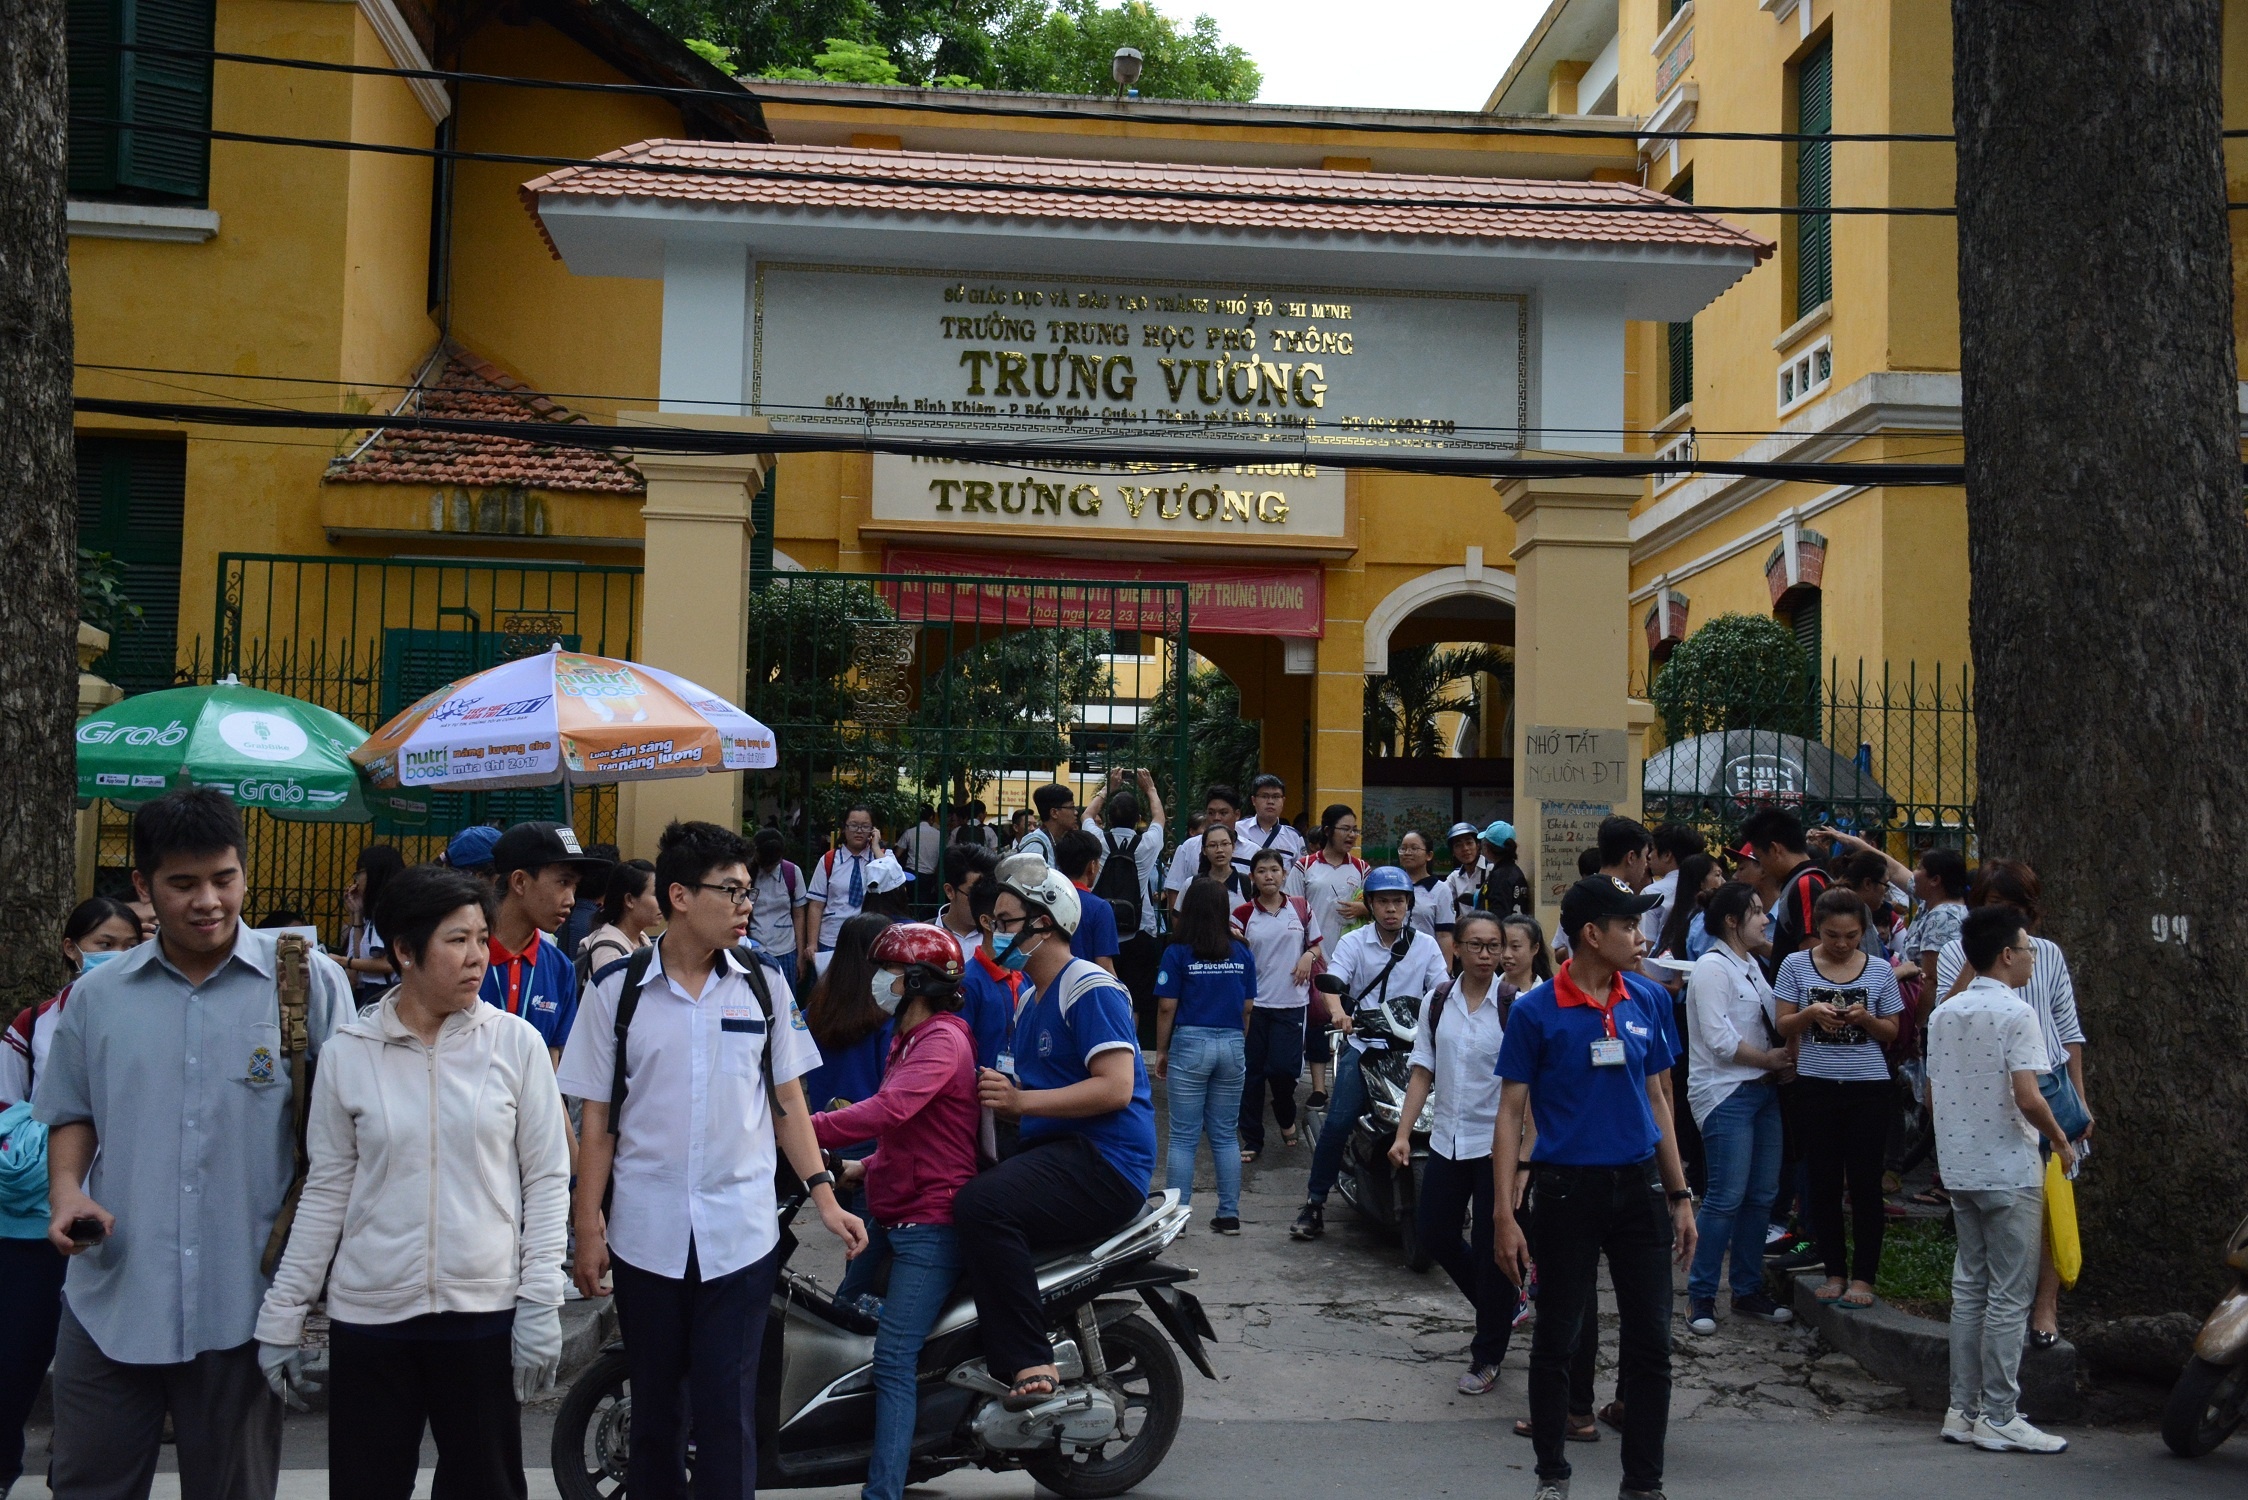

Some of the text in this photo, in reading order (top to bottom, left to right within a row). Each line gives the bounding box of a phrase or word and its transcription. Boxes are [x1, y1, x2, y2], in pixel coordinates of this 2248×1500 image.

[968, 285, 1007, 305] GIÁO
[1012, 286, 1044, 311] DỤC
[1050, 287, 1070, 309] VÀ
[1117, 295, 1148, 315] TẠO
[1311, 303, 1352, 320] MINH
[940, 310, 1354, 355] TRƯỜNG TRUNG HỌC PHỔ THÔNG
[959, 345, 1328, 408] TRƯNG VƯƠNG
[951, 400, 997, 416] Khiêm
[928, 476, 1290, 524] TRƯNG VƯƠNG
[1187, 582, 1212, 607] HPT
[1214, 580, 1258, 608] TRƯNG
[1261, 580, 1304, 610] VƯƠNG
[76, 720, 188, 747] Grab
[243, 741, 290, 752] GrabBike
[529, 740, 552, 752] cho
[1526, 728, 1600, 755] NHỚ TẮT
[484, 760, 505, 772] thi
[508, 756, 539, 770] 2017
[657, 746, 703, 765] lượng
[405, 763, 449, 780] boost
[1528, 759, 1626, 785] NGUỒN ĐT
[238, 777, 305, 803] Grab
[1737, 778, 1795, 792] DELI
[1566, 831, 1575, 842] 2
[2151, 913, 2188, 944] 99
[1051, 1272, 1101, 1301] BLADE
